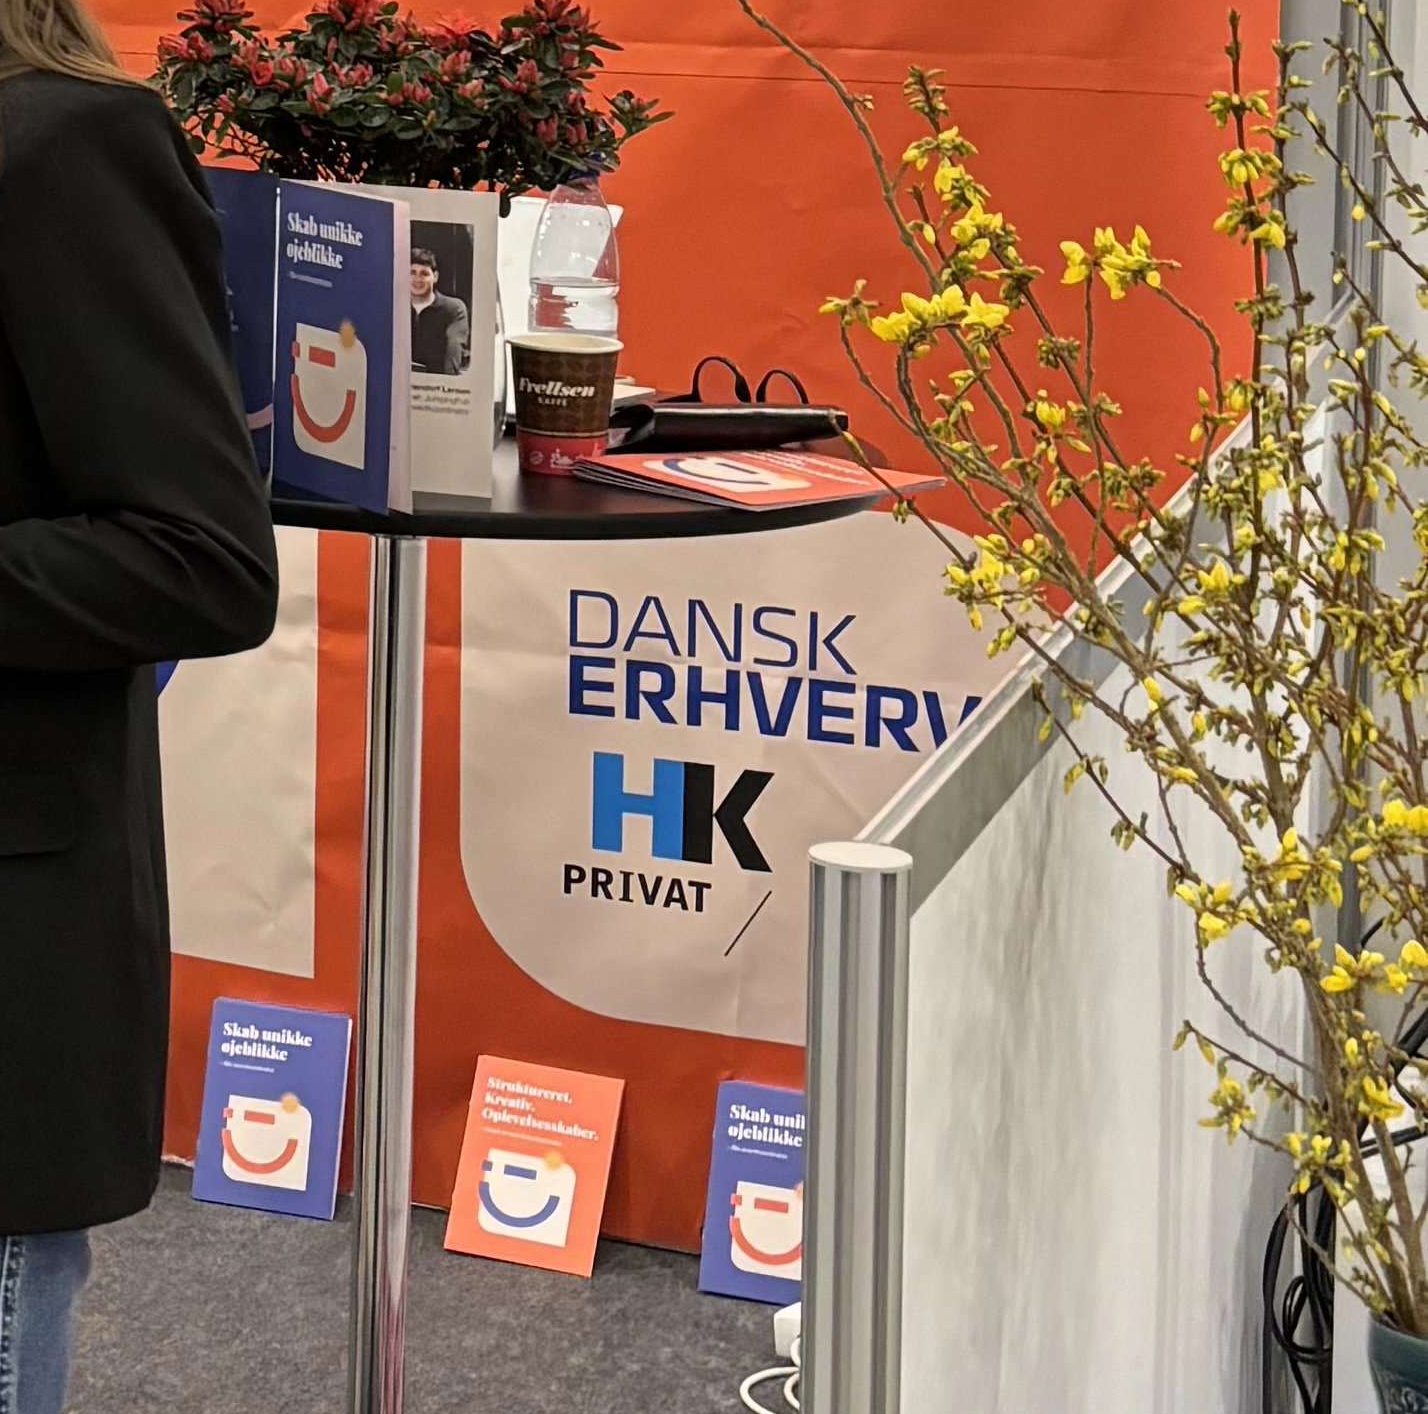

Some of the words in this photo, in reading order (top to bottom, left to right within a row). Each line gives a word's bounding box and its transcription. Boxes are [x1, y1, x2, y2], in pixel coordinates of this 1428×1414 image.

[287, 212, 317, 236] Skab
[320, 221, 363, 246] unikke
[519, 377, 595, 397] Frellsen
[569, 589, 857, 675] DANSK
[568, 655, 982, 754] ERHVERV
[593, 751, 775, 873] HK
[563, 864, 712, 913] PRIVAT
[221, 1040, 288, 1061] øjeblikke
[223, 1022, 259, 1040] Skab
[262, 1029, 312, 1047] unikke
[730, 1105, 770, 1123] Skab
